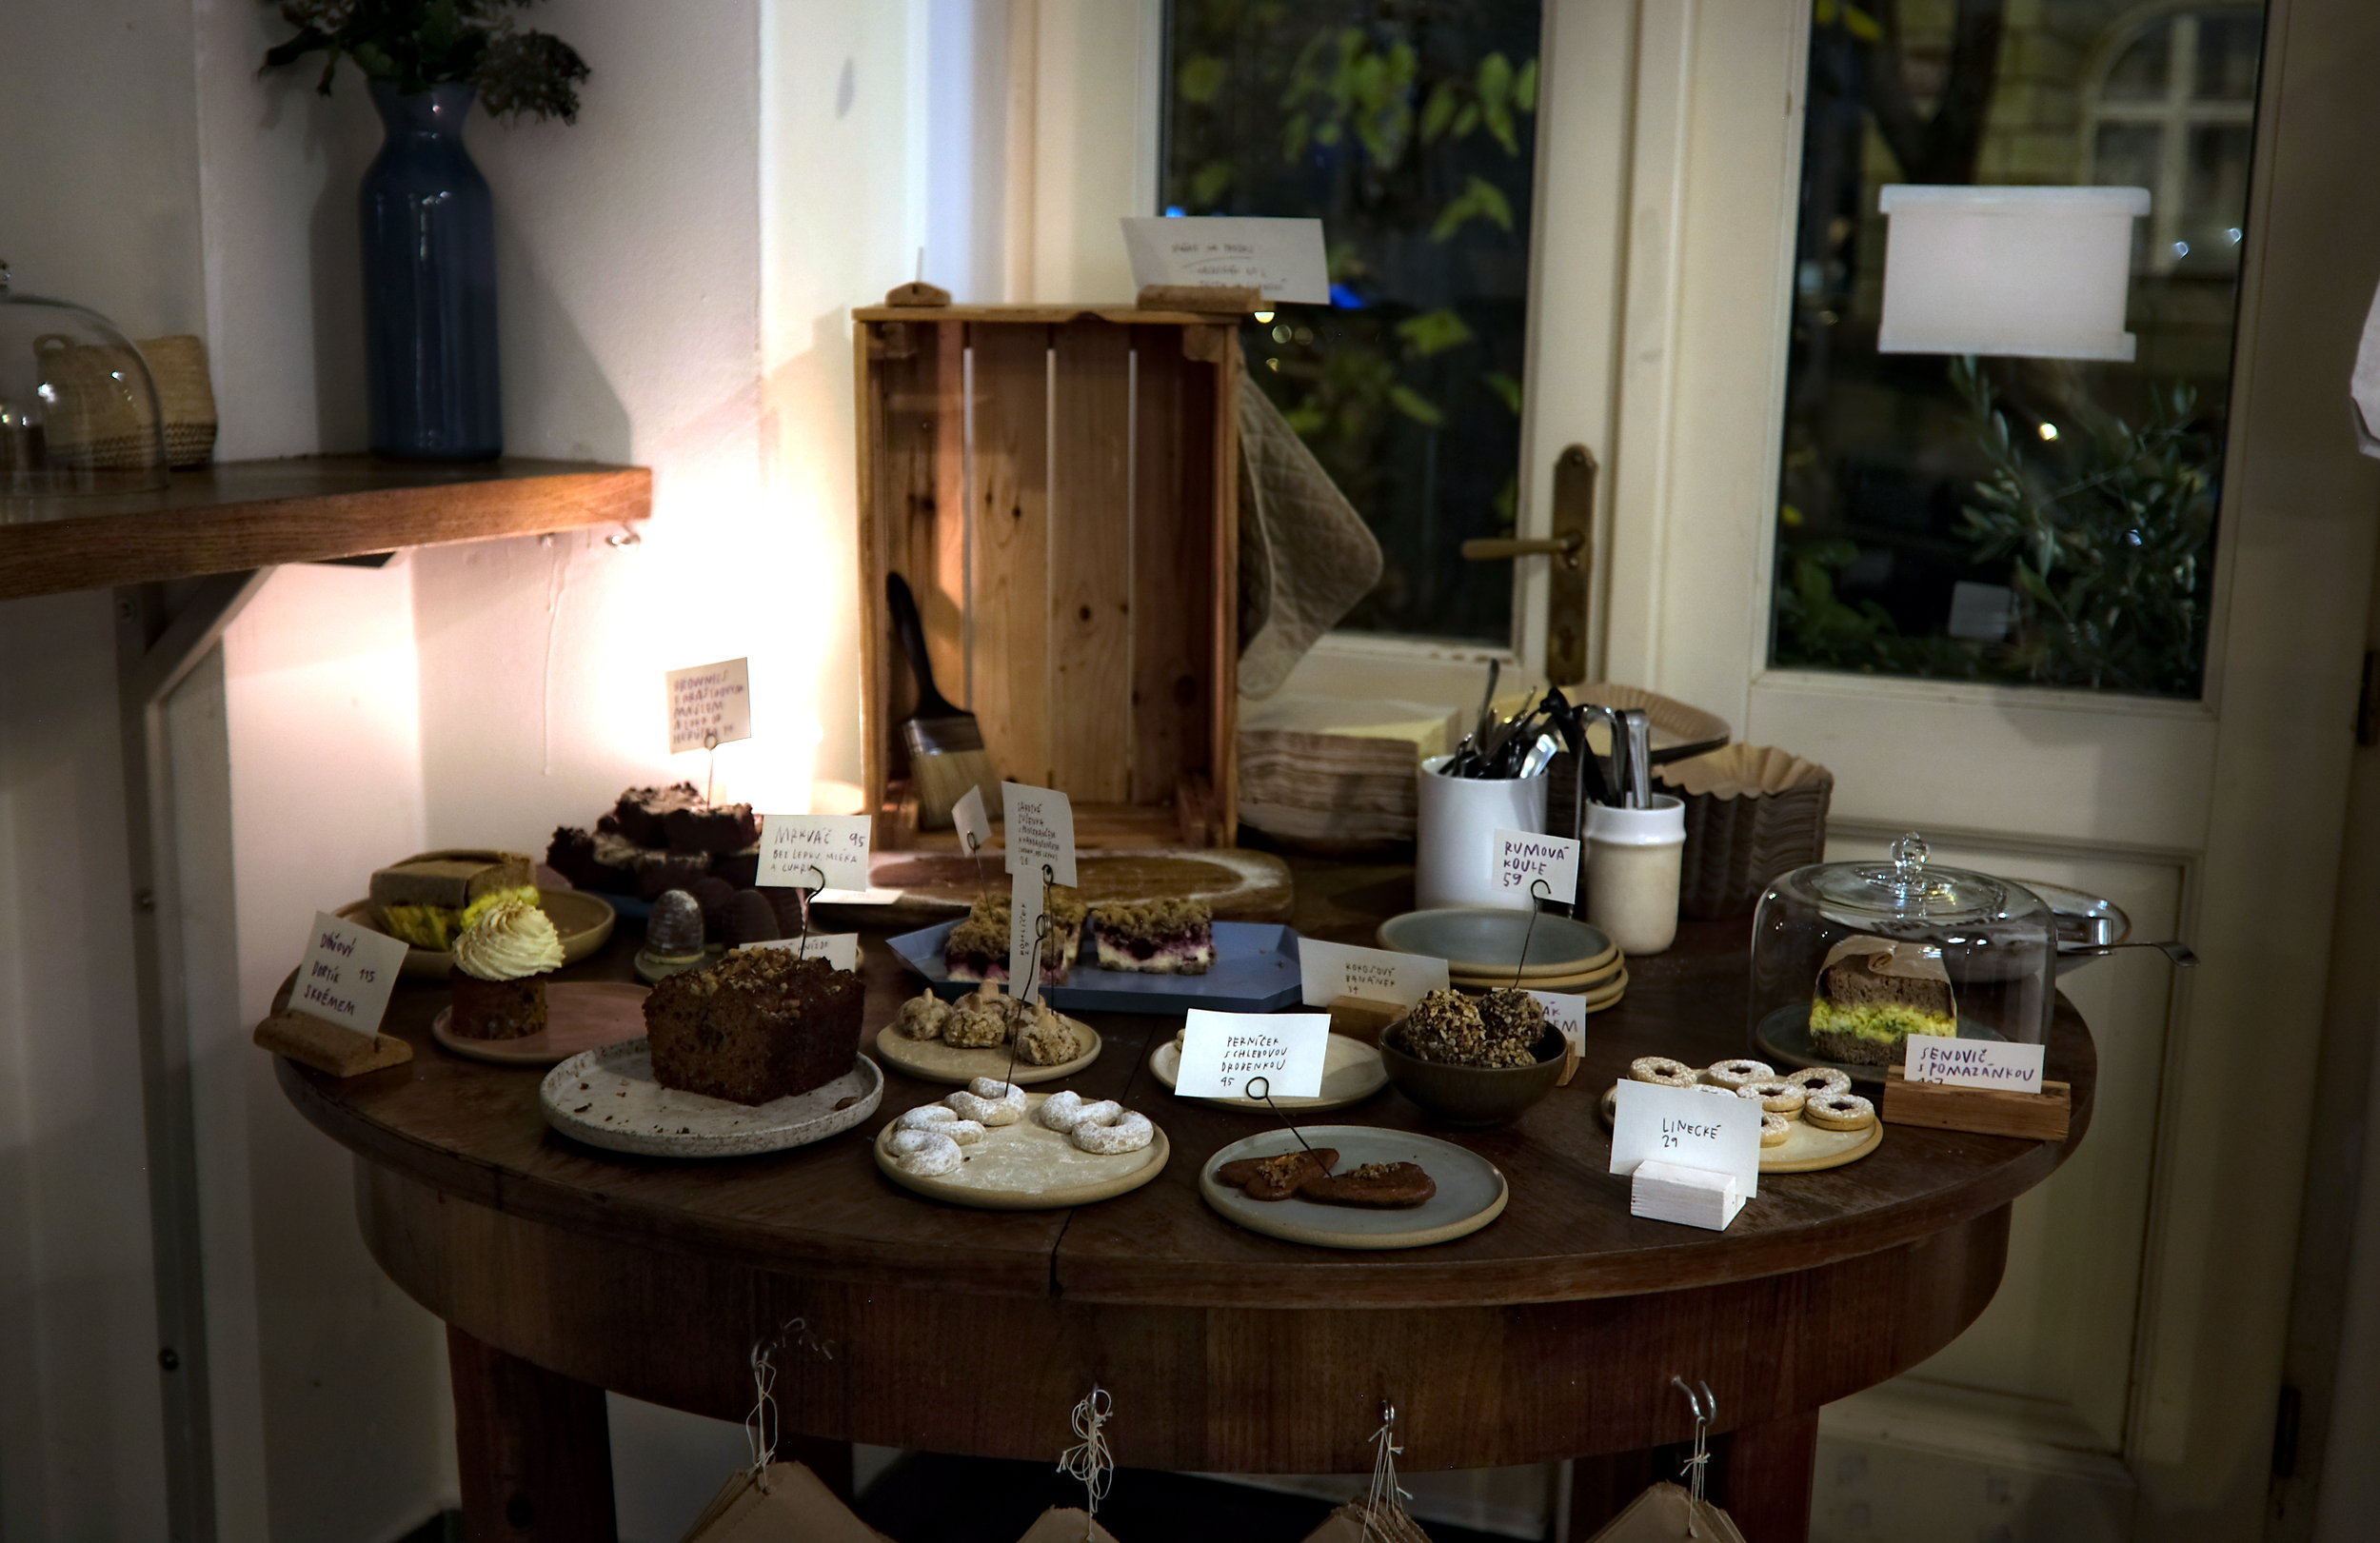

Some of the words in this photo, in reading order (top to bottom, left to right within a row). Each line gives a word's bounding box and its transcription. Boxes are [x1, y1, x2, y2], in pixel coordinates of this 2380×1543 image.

[849, 833, 867, 847] 95
[773, 849, 788, 860] BEZ
[769, 863, 777, 873] A
[1503, 858, 1547, 876] KOULE
[1503, 871, 1522, 887] 59
[359, 968, 376, 983] 115
[1920, 1047, 1988, 1064] SENDVIČ
[1221, 1059, 1286, 1073] DROBENKOU
[1918, 1063, 1924, 1073] S
[1662, 1118, 1722, 1140] LINECKÉ
[1661, 1135, 1678, 1148] 29
